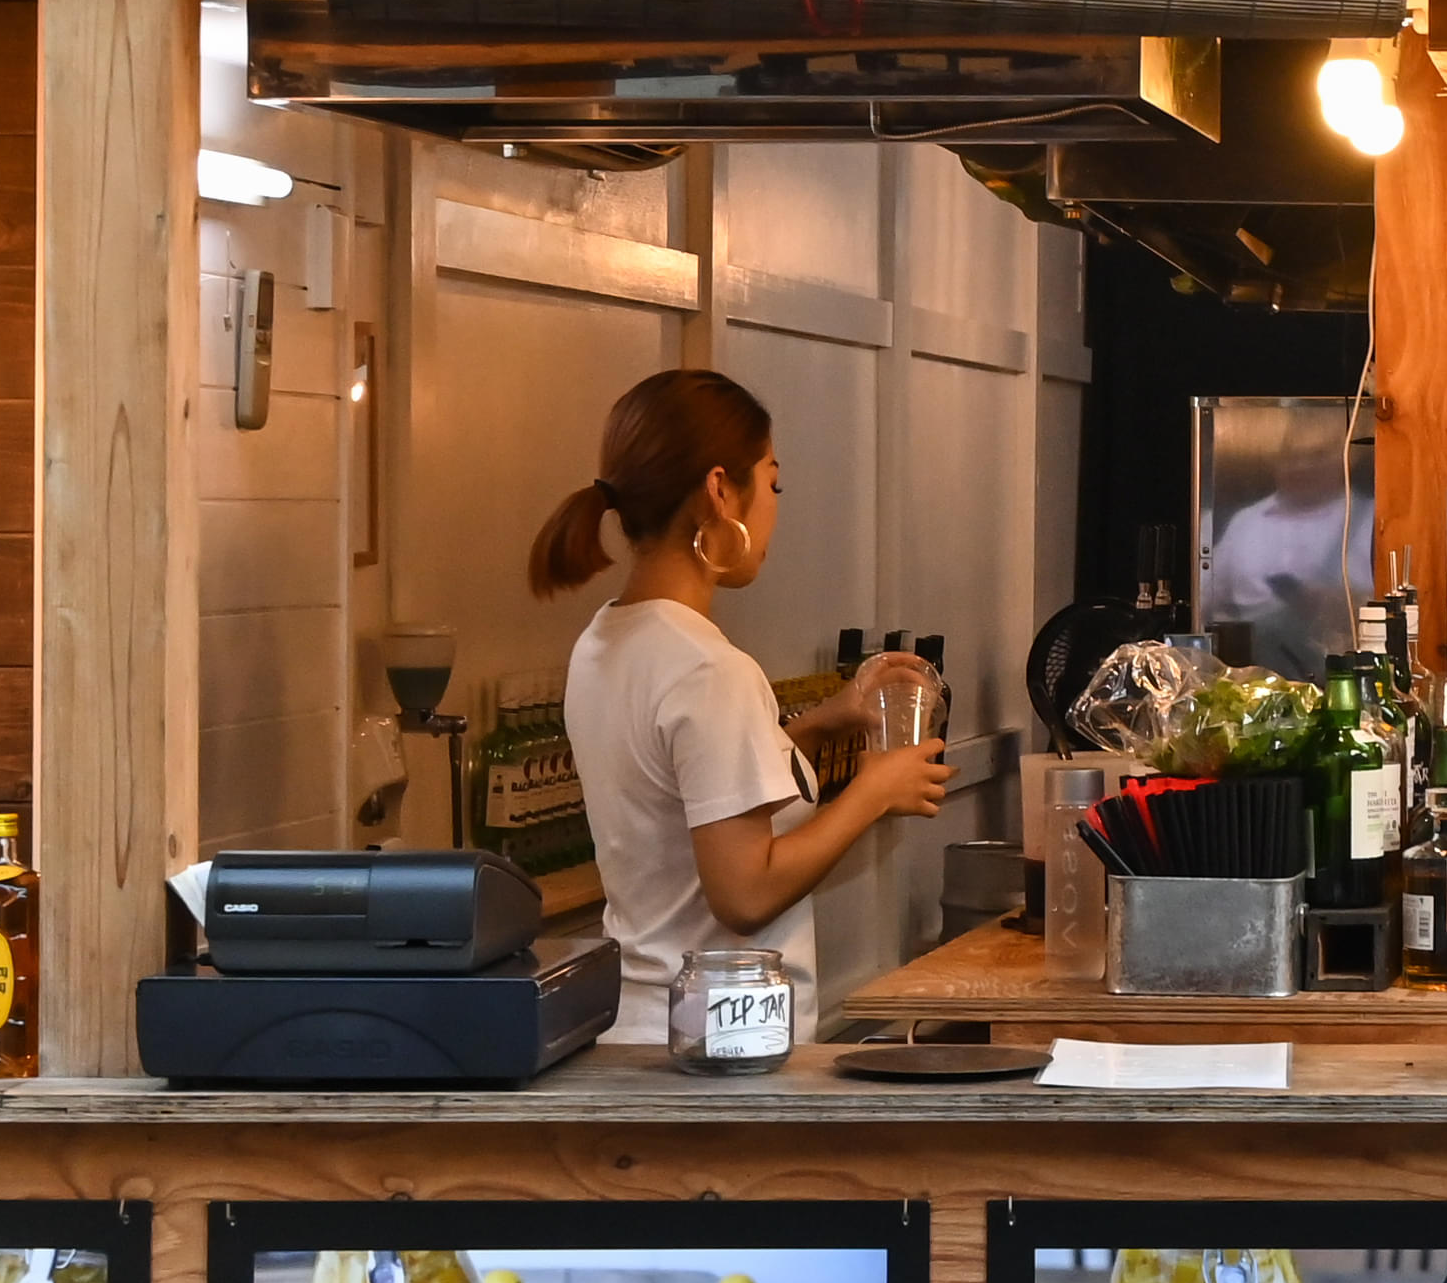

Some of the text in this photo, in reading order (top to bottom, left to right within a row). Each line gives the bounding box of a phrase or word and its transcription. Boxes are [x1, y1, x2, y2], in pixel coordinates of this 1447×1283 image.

[223, 903, 259, 913] CASIO
[707, 992, 786, 1028] TIP JAR
